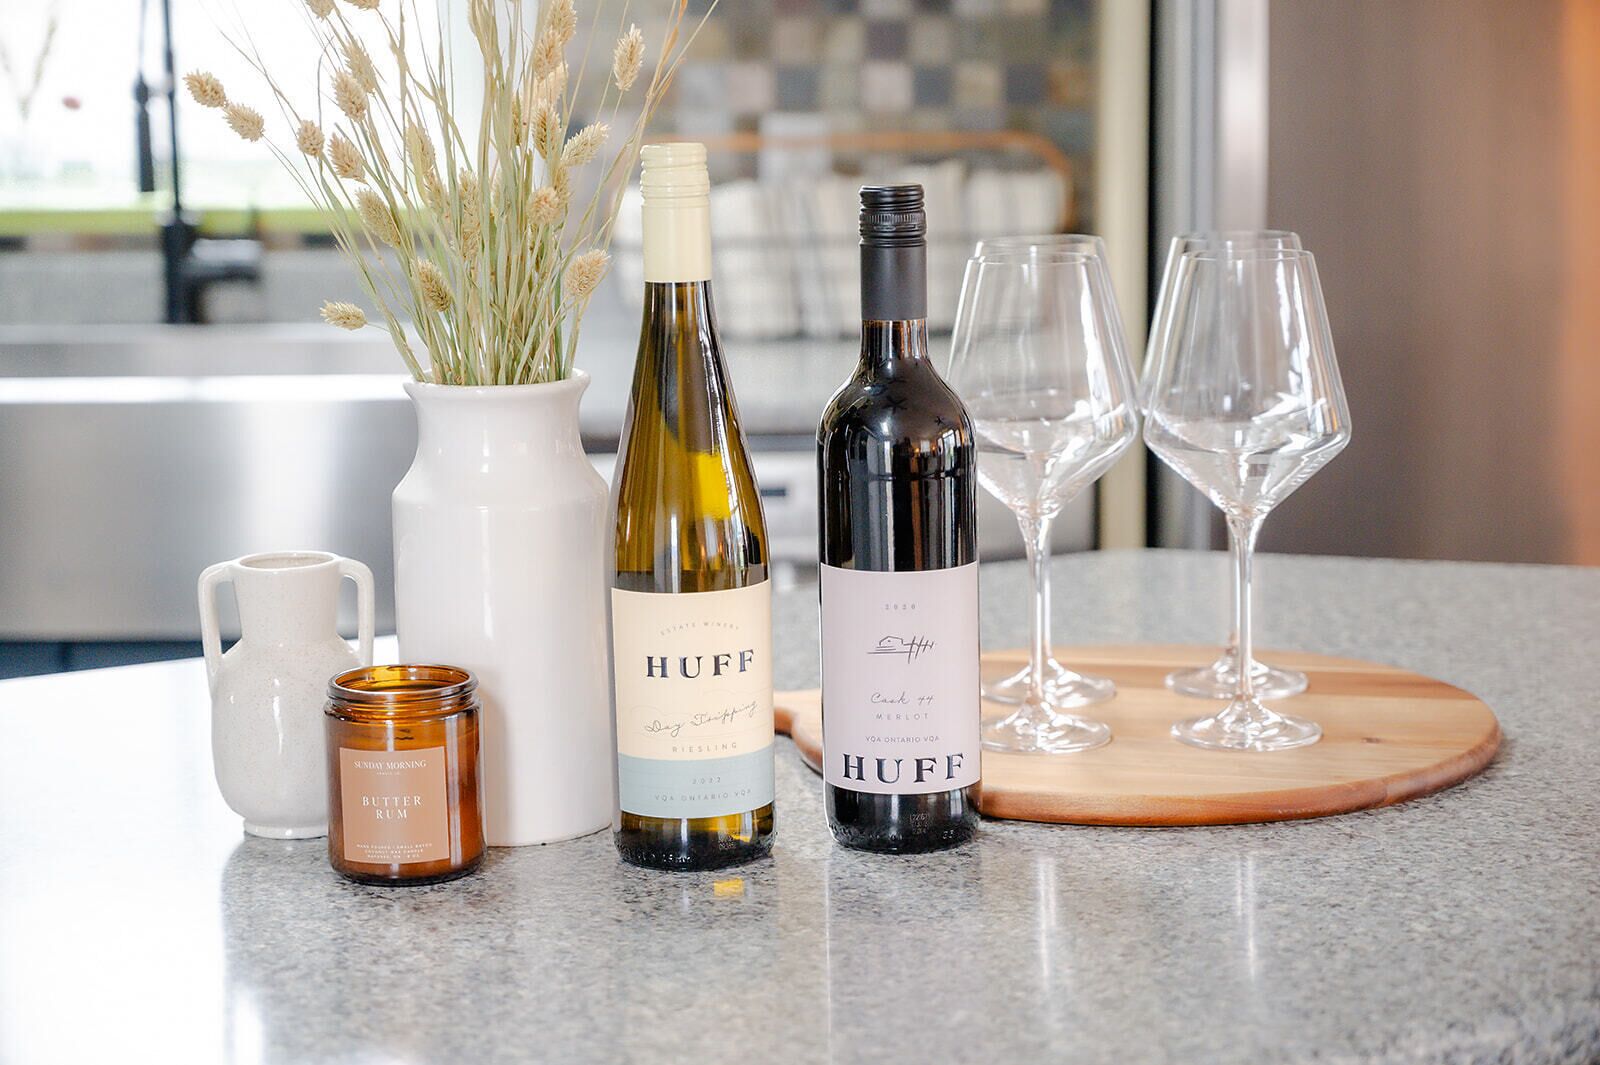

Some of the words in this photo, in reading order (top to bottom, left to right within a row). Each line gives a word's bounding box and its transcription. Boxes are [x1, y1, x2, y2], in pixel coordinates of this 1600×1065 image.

[660, 622, 696, 636] ESTATE
[703, 621, 740, 631] WINERY
[646, 649, 754, 678] HUFF
[870, 691, 910, 704] Cask
[917, 694, 935, 706] 44
[645, 719, 686, 738] Day
[690, 701, 758, 727] Tripping
[876, 713, 929, 721] MERLOT
[865, 736, 882, 744] VQA
[924, 735, 940, 743] VQA
[672, 742, 737, 753] RIESLING
[353, 760, 384, 769] SUNDAY
[386, 760, 427, 769] MORNING
[842, 752, 964, 784] HUFF
[692, 776, 721, 785] 2022
[362, 795, 422, 807] BUTTER
[680, 792, 729, 801] ONTARIO
[376, 809, 408, 819] RUM
